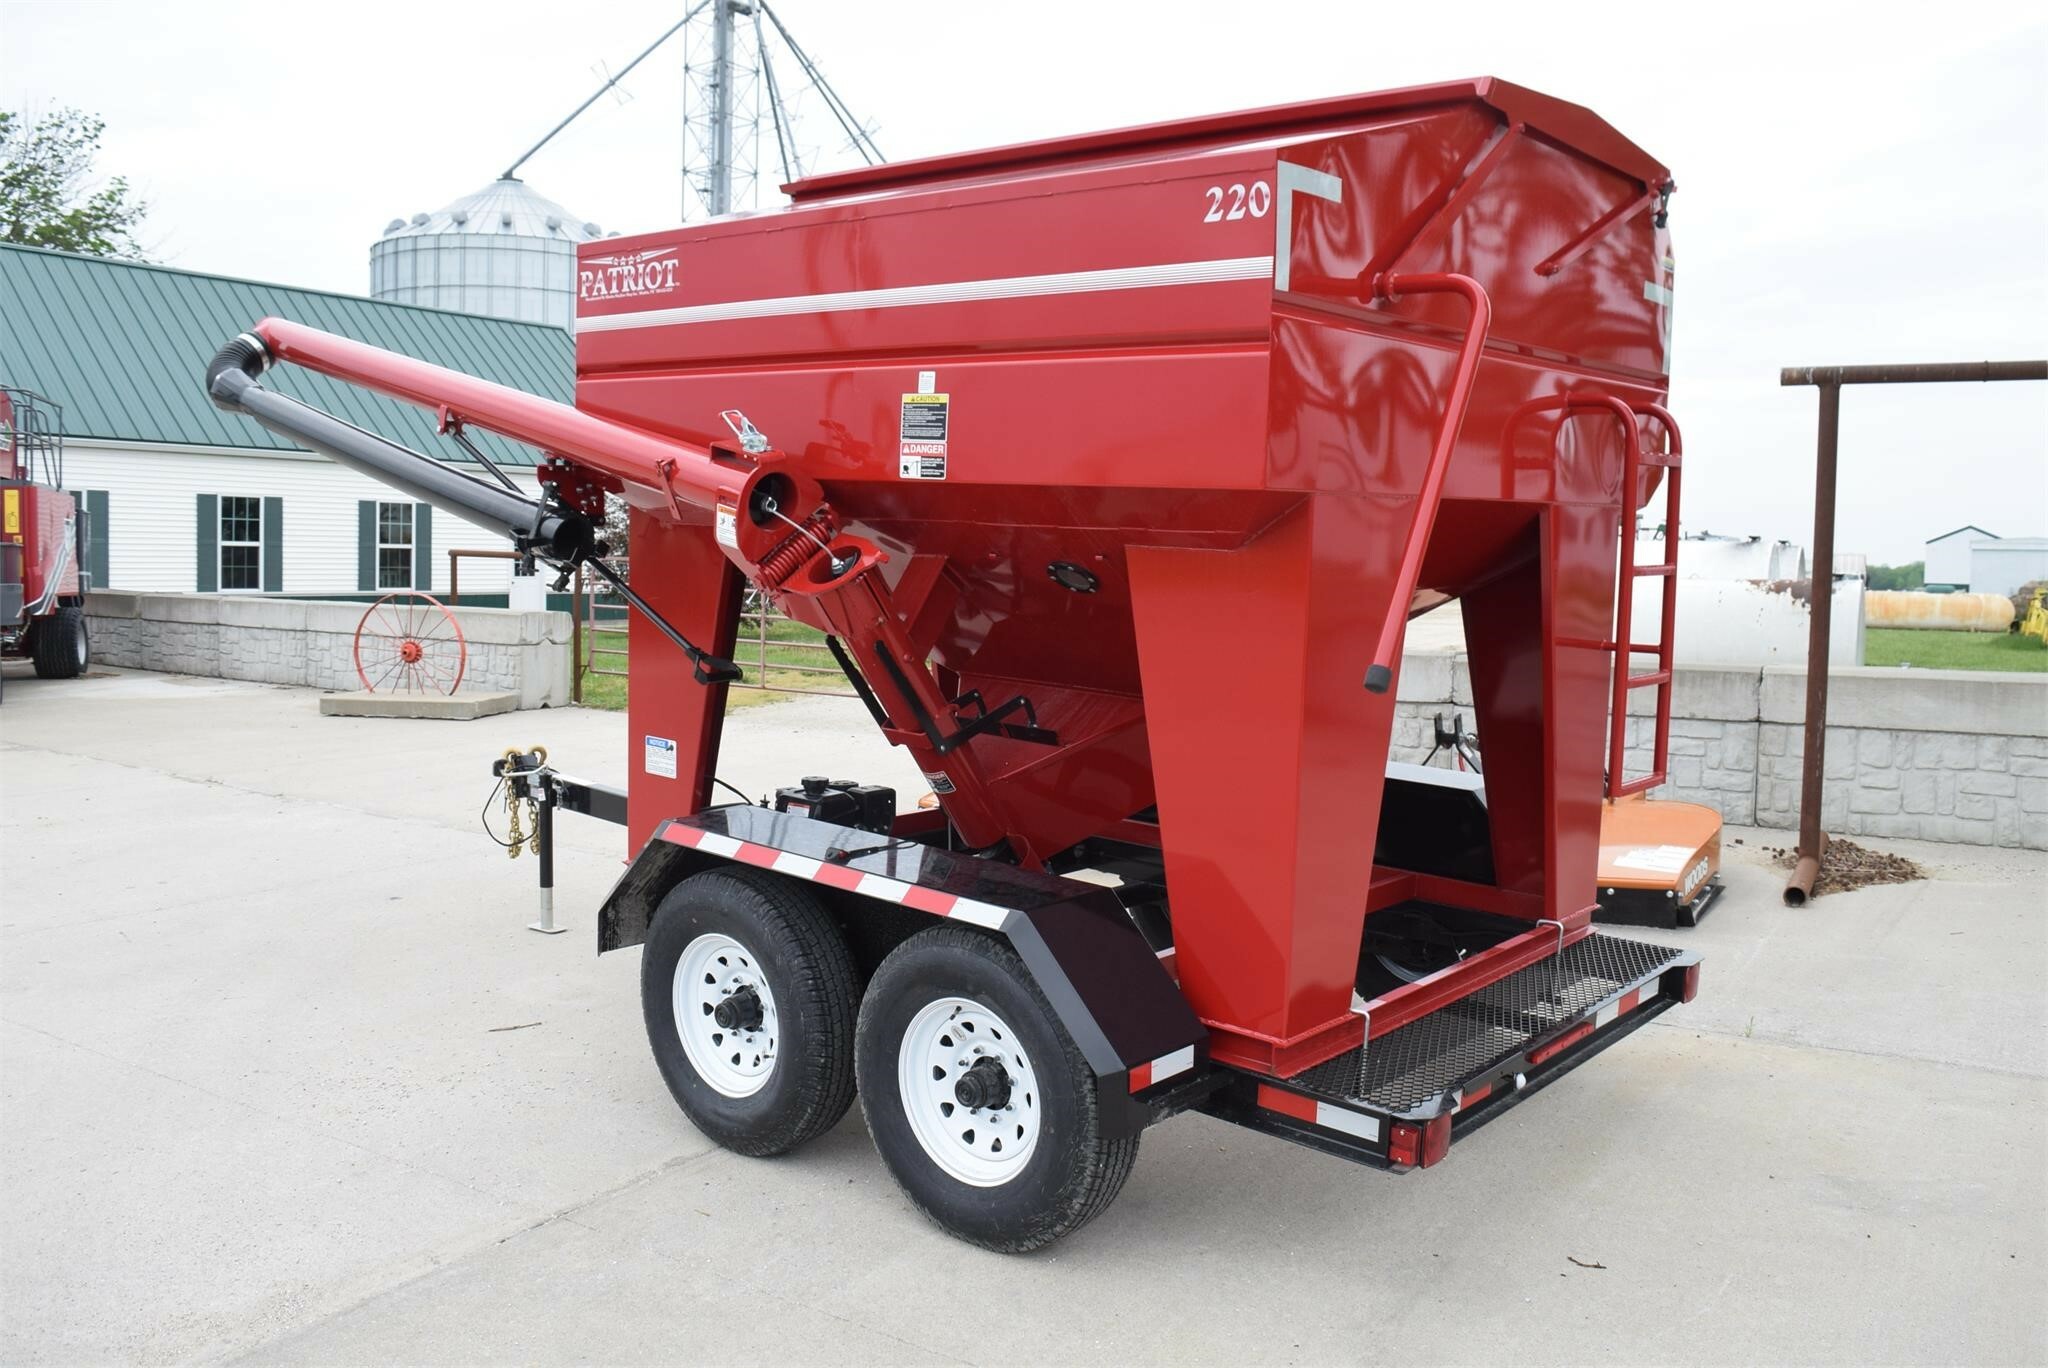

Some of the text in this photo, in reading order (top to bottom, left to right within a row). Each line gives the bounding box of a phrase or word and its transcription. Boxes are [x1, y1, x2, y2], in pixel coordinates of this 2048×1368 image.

[1203, 180, 1271, 223] 220
[580, 259, 679, 298] PATRIOT
[910, 444, 944, 454] DANGER
[1684, 855, 1709, 897] WOODS
